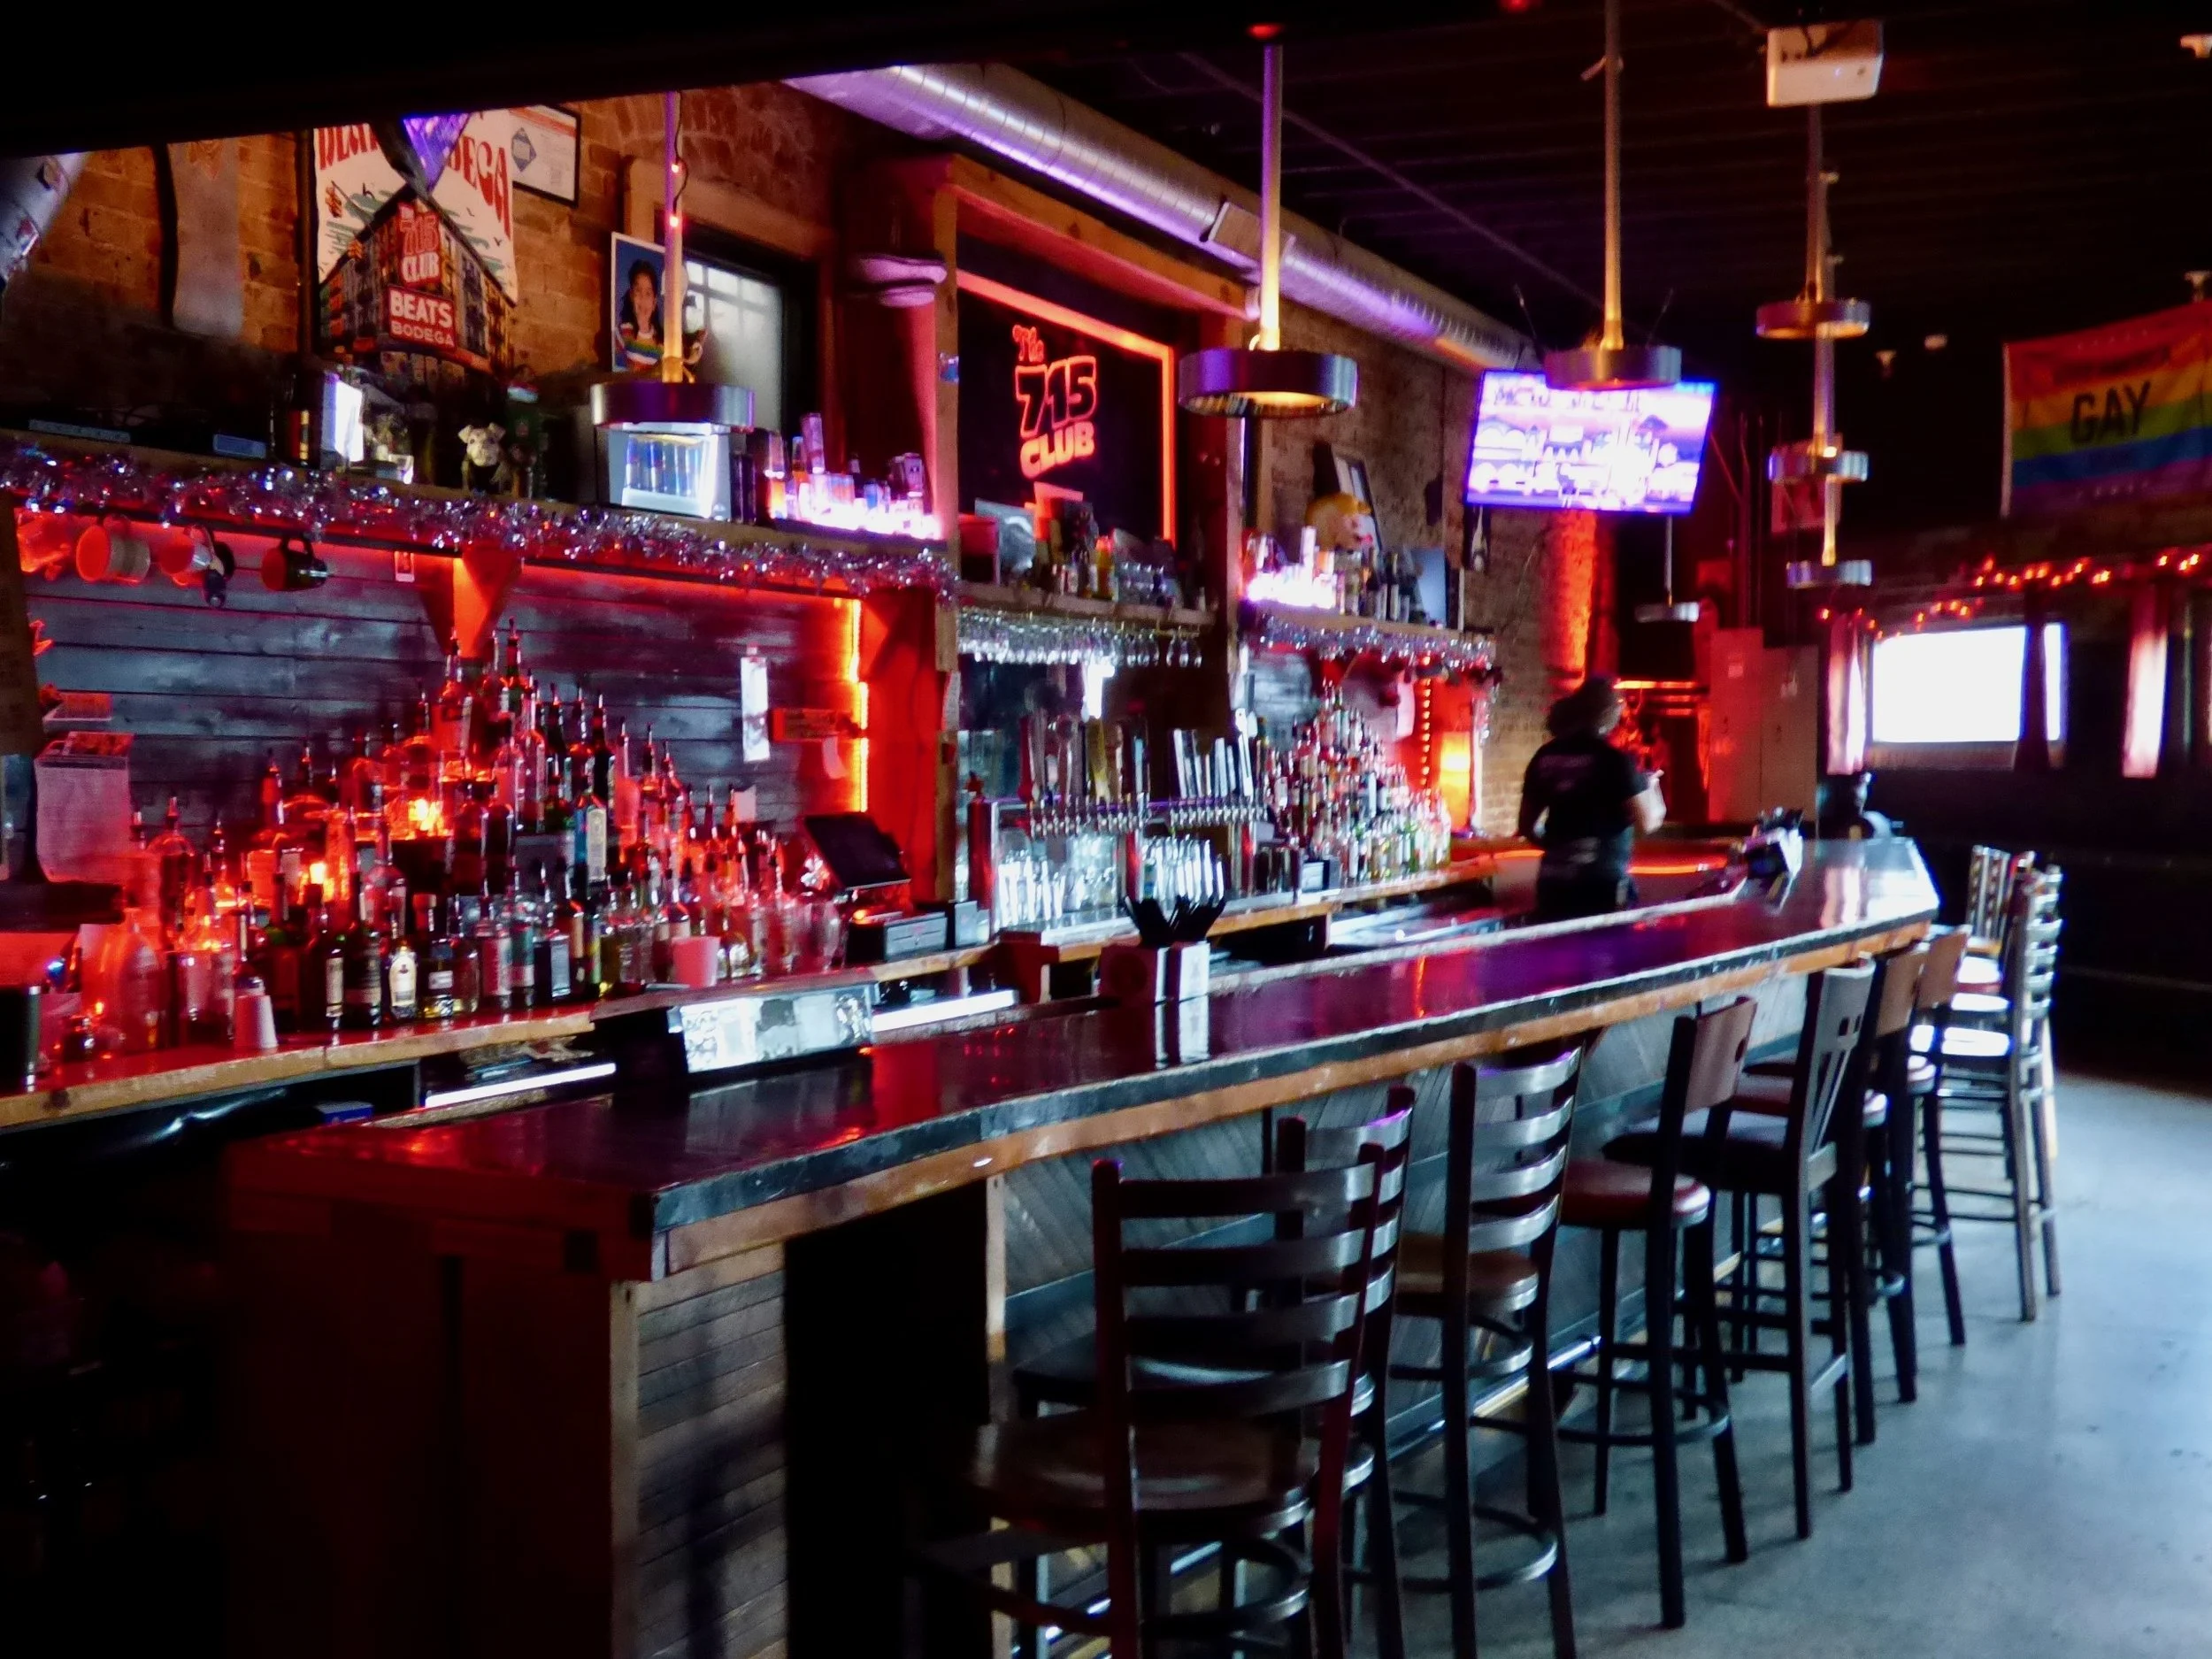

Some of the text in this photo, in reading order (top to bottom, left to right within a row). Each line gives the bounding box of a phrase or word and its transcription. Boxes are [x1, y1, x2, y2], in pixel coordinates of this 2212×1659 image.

[389, 288, 454, 329] BEATS
[390, 319, 456, 349] BODEGA
[1015, 355, 1097, 440] 715
[2071, 380, 2151, 443] GAY
[1020, 420, 1095, 480] CLUB
